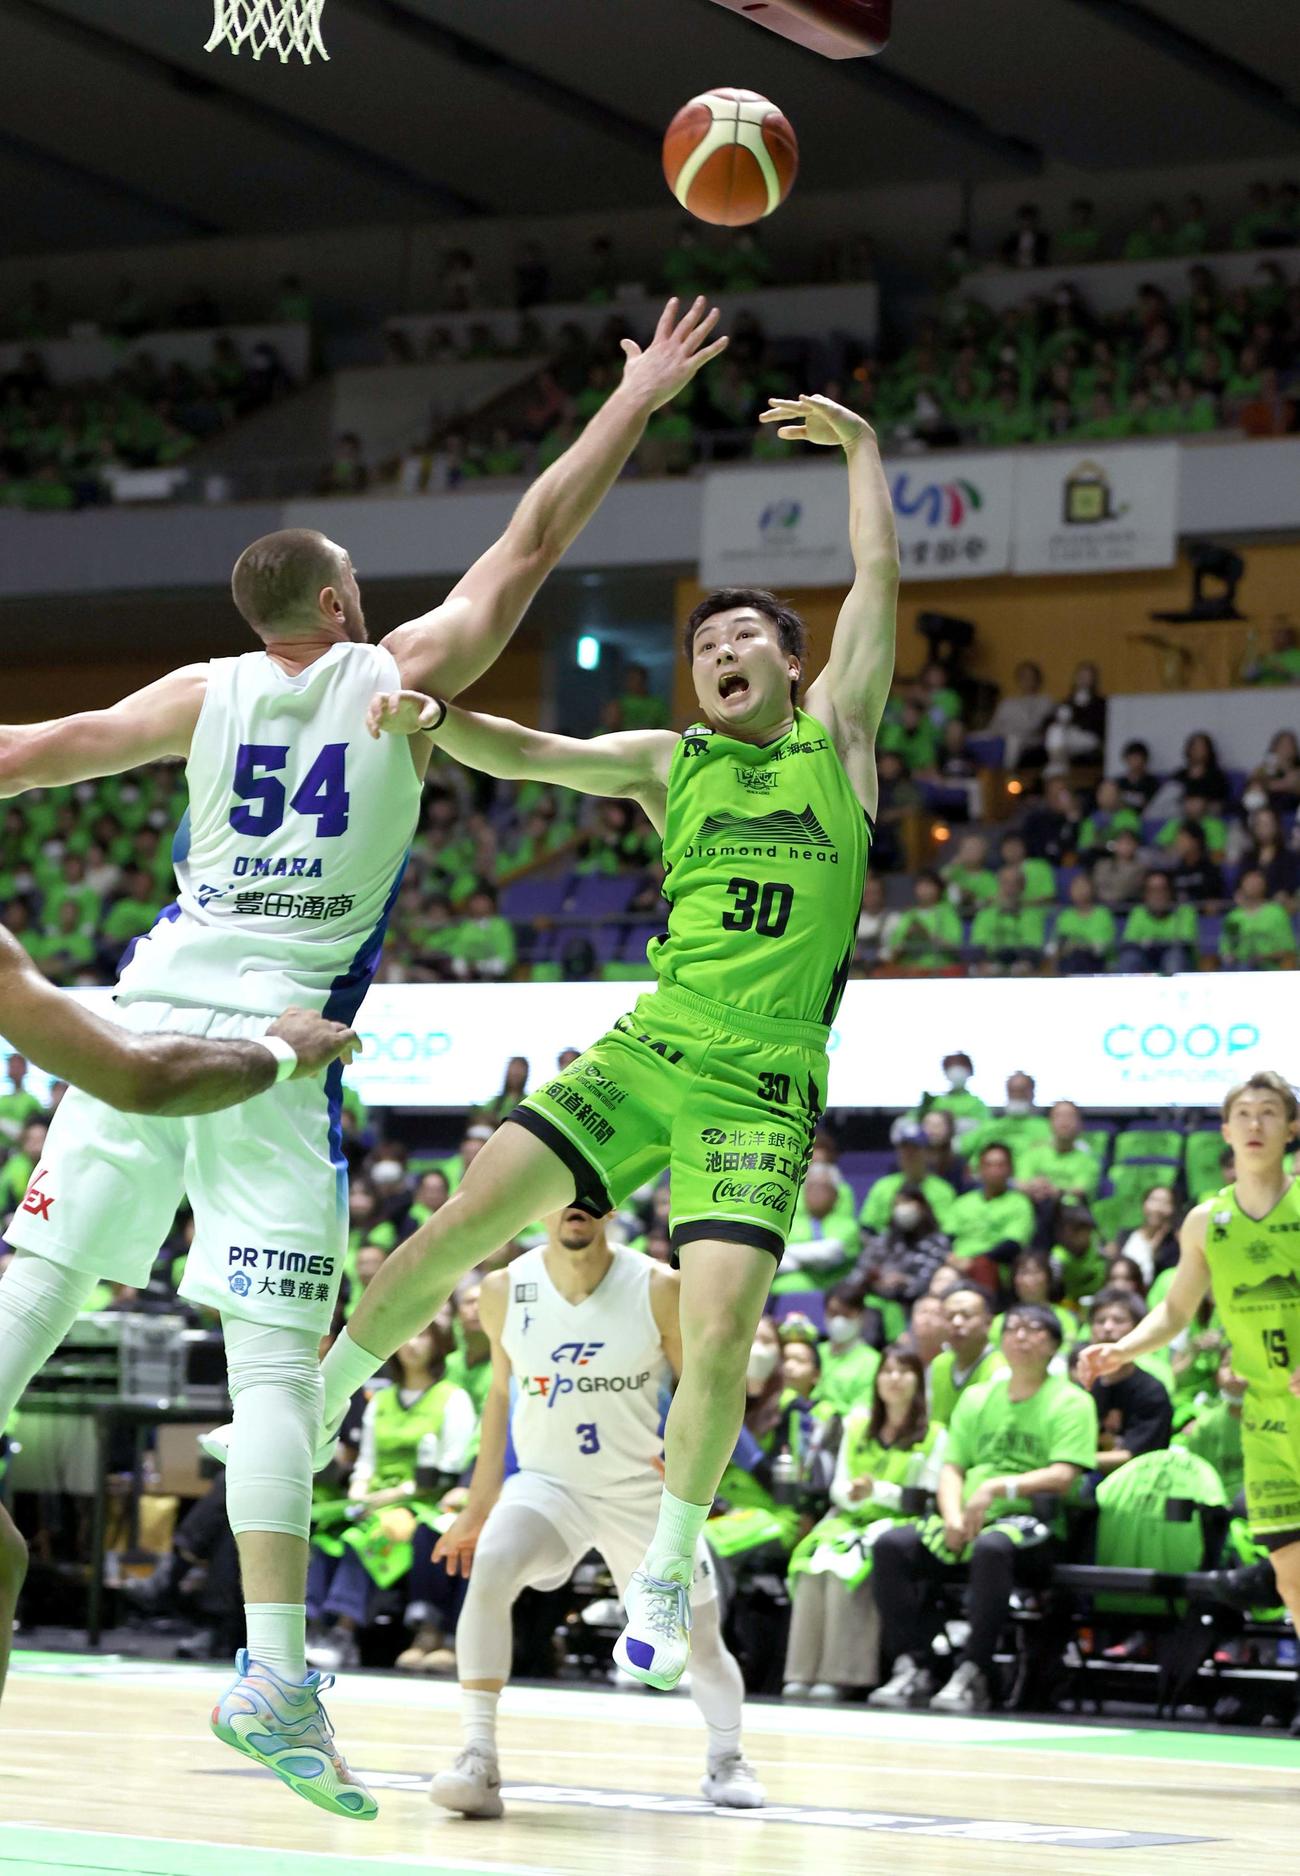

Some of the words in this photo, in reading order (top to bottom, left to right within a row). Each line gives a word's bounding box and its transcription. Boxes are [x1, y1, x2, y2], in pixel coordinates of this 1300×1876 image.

[229, 742, 350, 838] 54
[233, 856, 323, 878] O'MARA
[684, 845, 777, 859] Diamond
[789, 846, 839, 865] head
[232, 891, 357, 920] 豊田通商
[722, 877, 795, 938] 30
[353, 1030, 453, 1062] OOP
[1103, 1023, 1261, 1060] COOP
[757, 1072, 791, 1104] 30
[728, 1129, 801, 1155] 北洋銀行
[228, 1246, 259, 1268] PR
[262, 1249, 335, 1276] TIMES
[1262, 1328, 1290, 1369] 15
[577, 1371, 650, 1394] GROUP
[576, 1422, 601, 1455] 3
